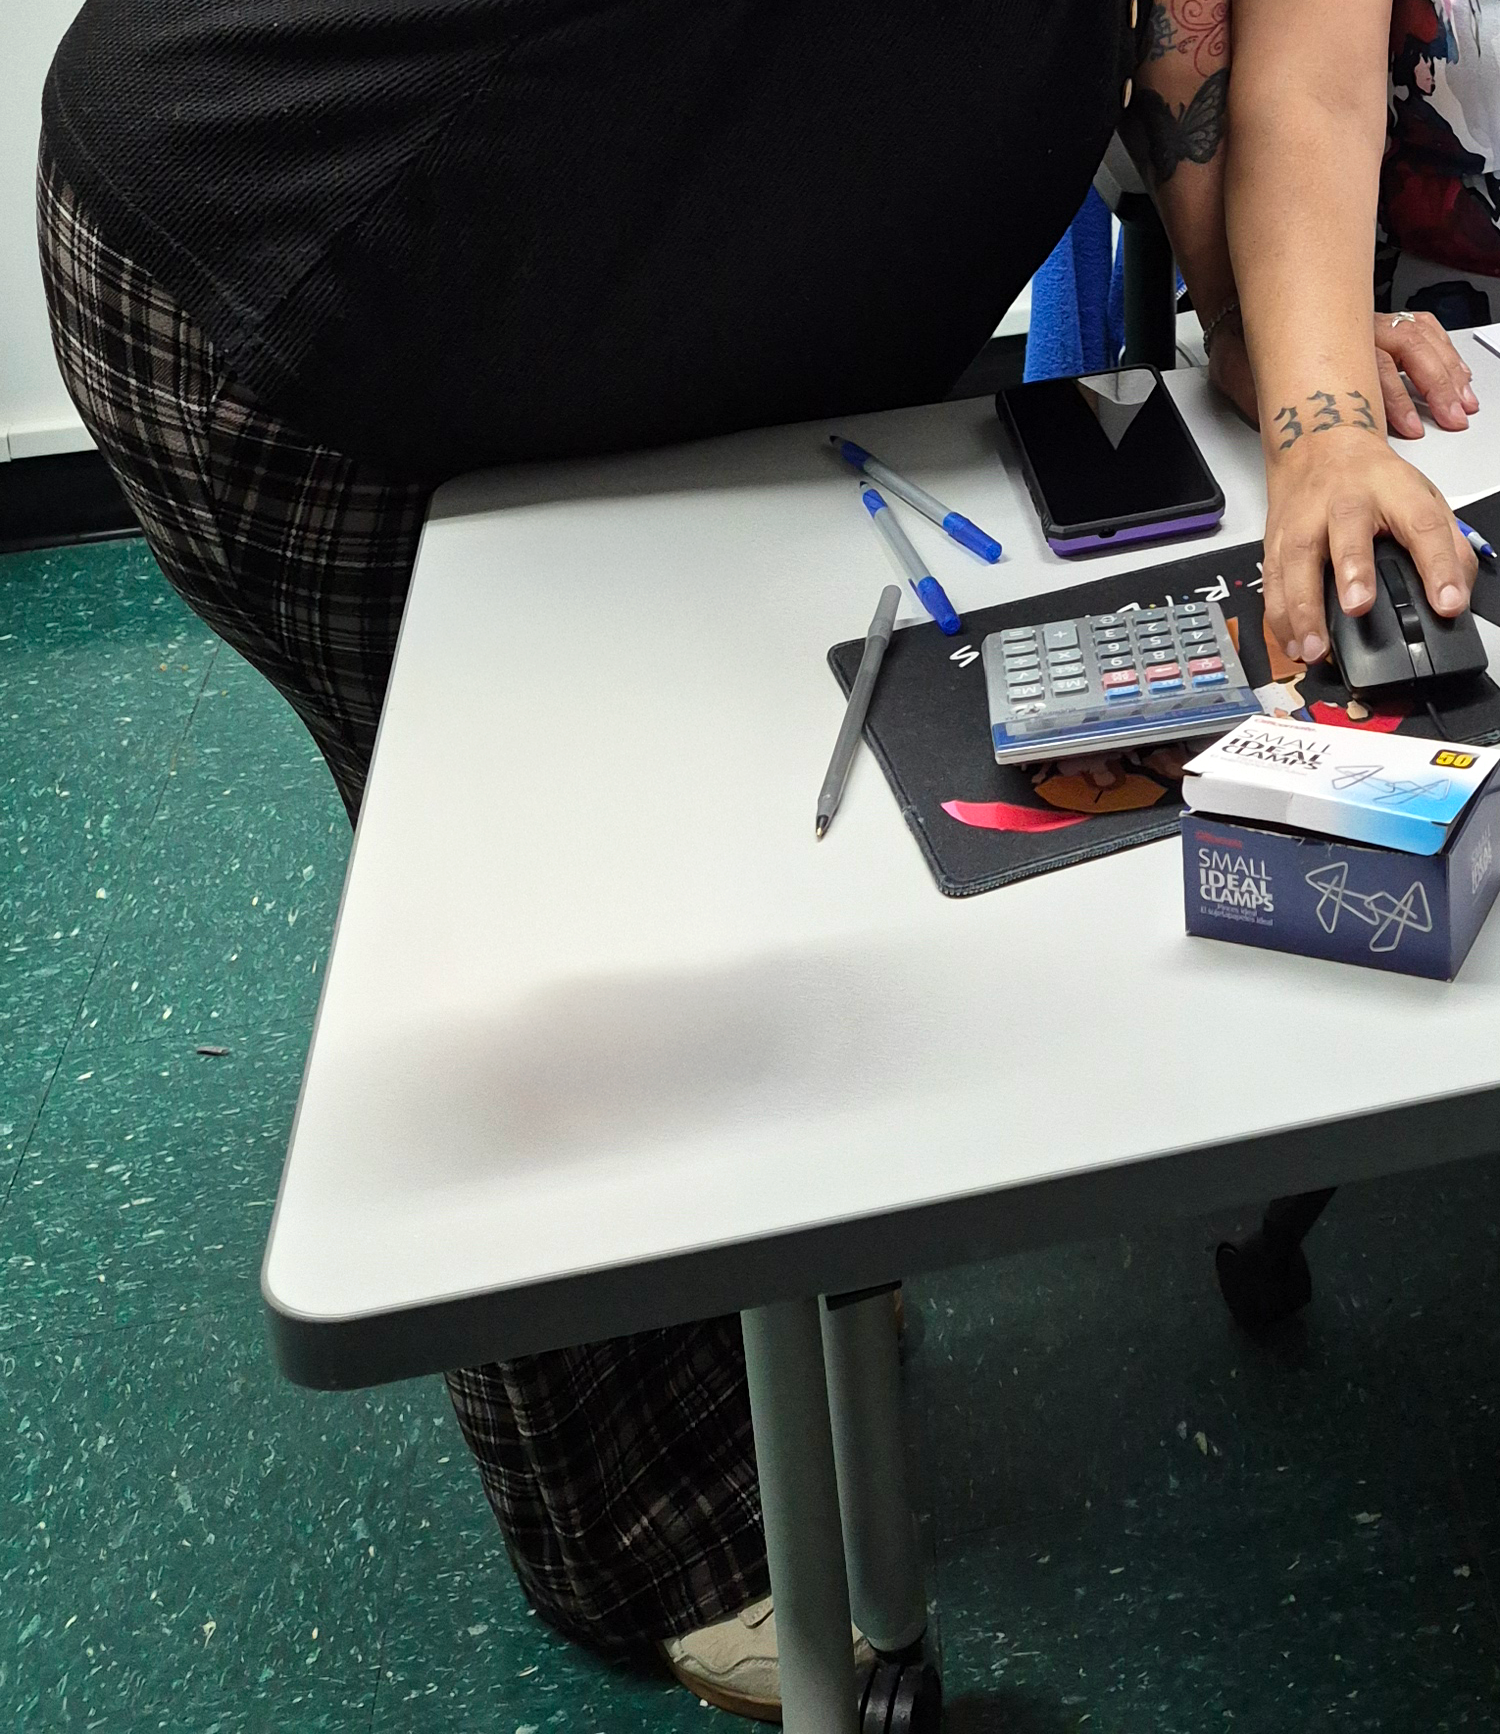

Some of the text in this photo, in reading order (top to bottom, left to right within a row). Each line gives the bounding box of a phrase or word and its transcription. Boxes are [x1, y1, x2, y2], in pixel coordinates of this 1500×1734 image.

[1273, 390, 1379, 451] 333
[1147, 623, 1157, 631] 2
[1104, 630, 1116, 638] 3
[1192, 631, 1203, 640] 4
[1150, 637, 1162, 645] 5
[1107, 643, 1120, 652] 6
[1196, 645, 1208, 654] 7
[1153, 651, 1165, 659] 8
[1111, 657, 1123, 666] 9
[1237, 728, 1331, 755] SMALL
[1222, 745, 1318, 770] CLAMPS
[1229, 738, 1322, 765] IDEAL
[1436, 751, 1473, 767] 50
[1198, 848, 1273, 881] SMALL
[1200, 868, 1273, 901] IDEAL
[1200, 885, 1274, 912] CLAMPS
